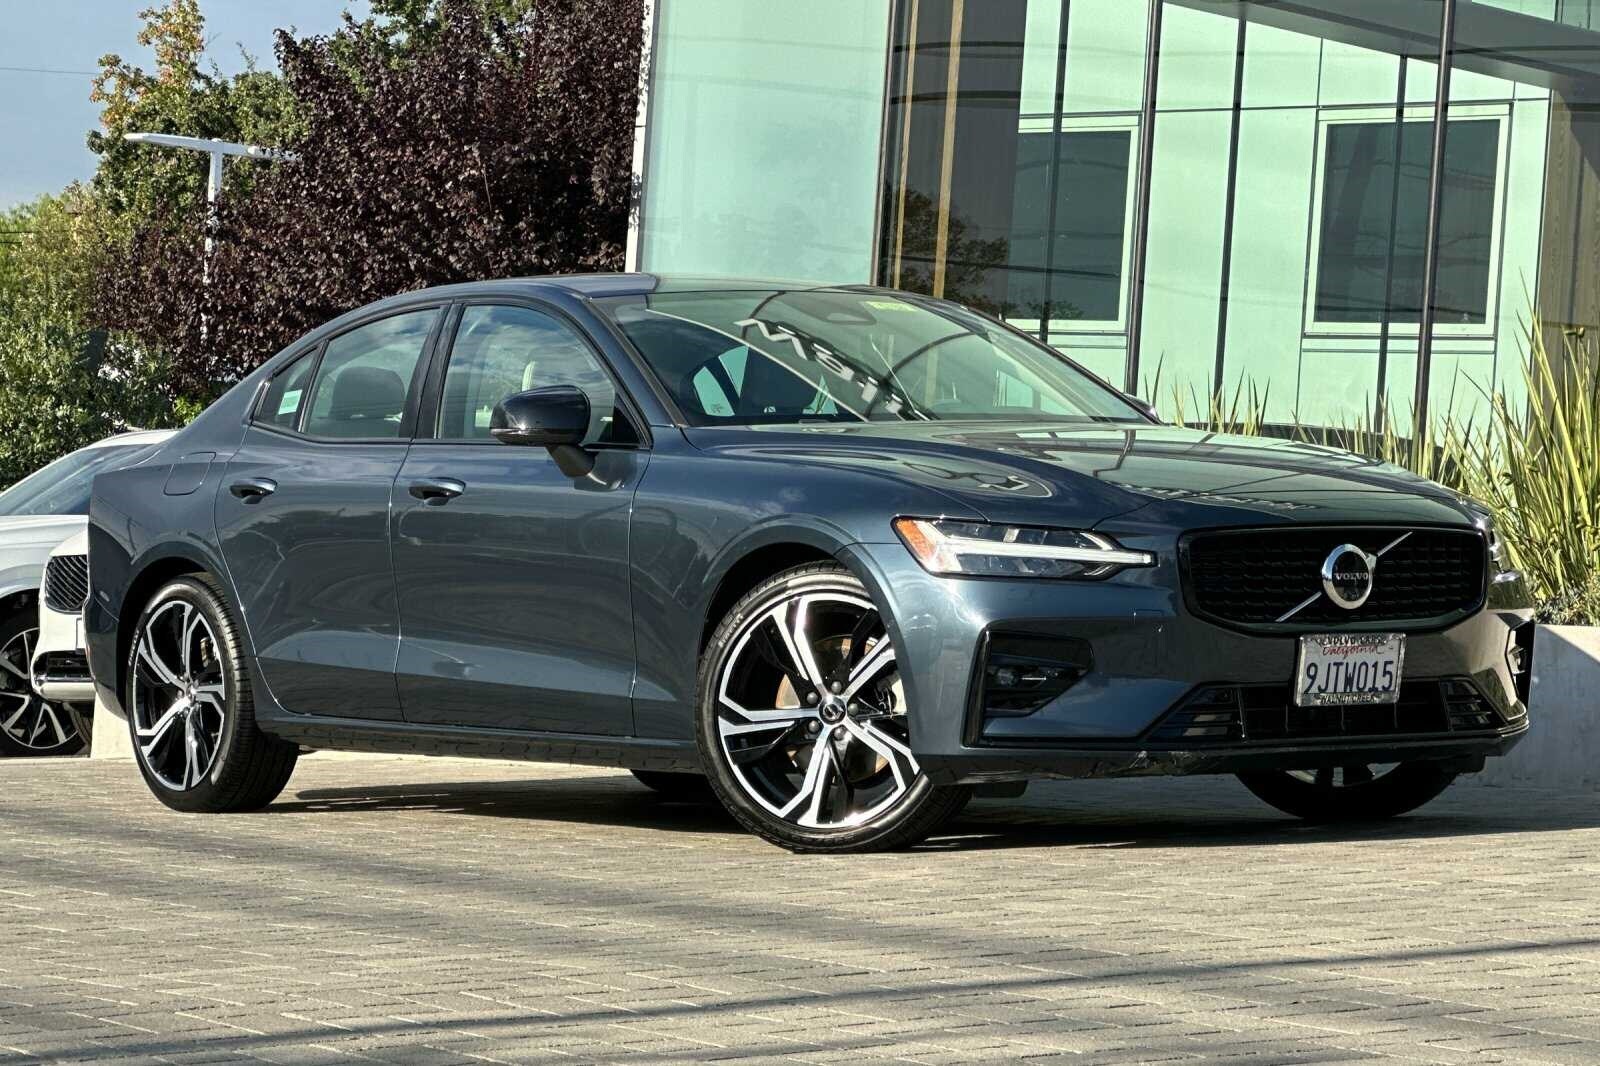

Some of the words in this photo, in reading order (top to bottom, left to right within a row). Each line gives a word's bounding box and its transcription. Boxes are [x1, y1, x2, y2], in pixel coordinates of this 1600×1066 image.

[1334, 572, 1369, 581] VOLVO
[1322, 645, 1378, 659] California
[1304, 660, 1395, 694] 9JTW015
